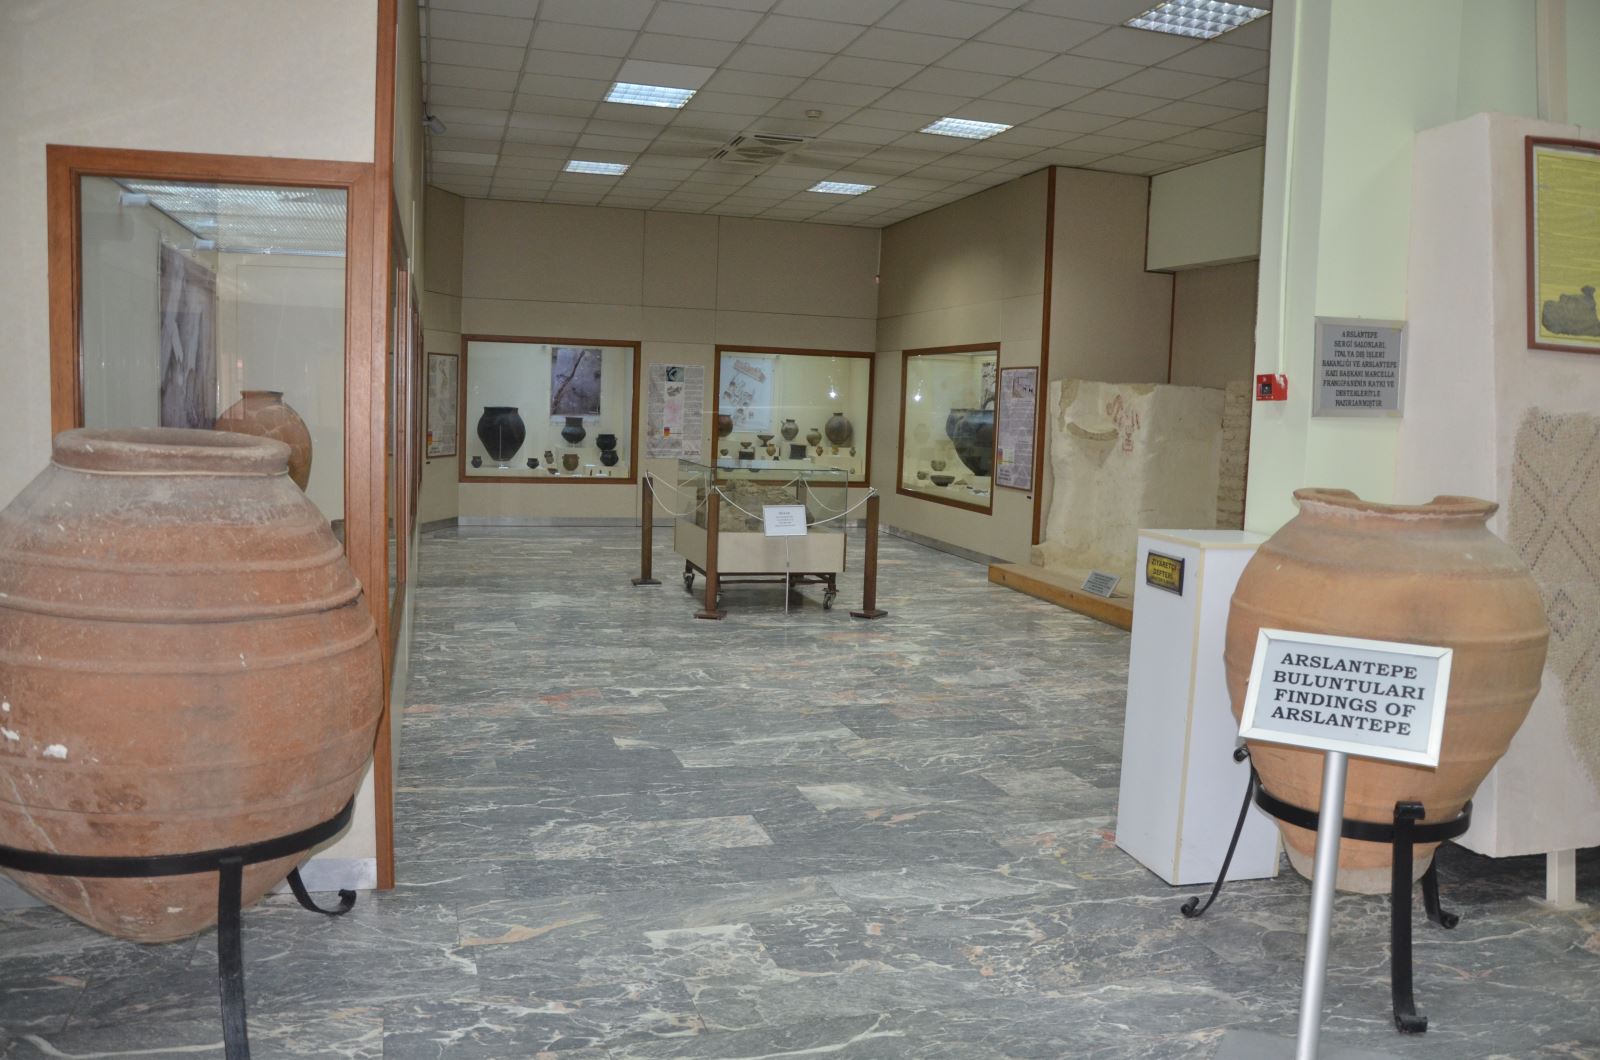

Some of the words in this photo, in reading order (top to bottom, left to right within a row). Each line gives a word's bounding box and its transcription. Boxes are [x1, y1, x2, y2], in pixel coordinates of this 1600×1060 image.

[1341, 331, 1378, 339] ARSLANTEPE
[1333, 339, 1353, 348] SERGİ
[1321, 359, 1352, 368] BAKANLIĞI
[1361, 361, 1398, 369] ARSLANTEPE
[1339, 370, 1363, 379] BAŞKANI
[1364, 370, 1395, 378] MARCELLA
[1367, 380, 1386, 388] KATKI
[1387, 380, 1395, 388] VE
[1280, 652, 1418, 680] ARSLANTEPE
[1272, 670, 1426, 701] BULUNTULARI
[1274, 688, 1377, 713] FINDINGS
[1385, 701, 1416, 718] OF
[1270, 706, 1411, 736] ARSLANTEPE
